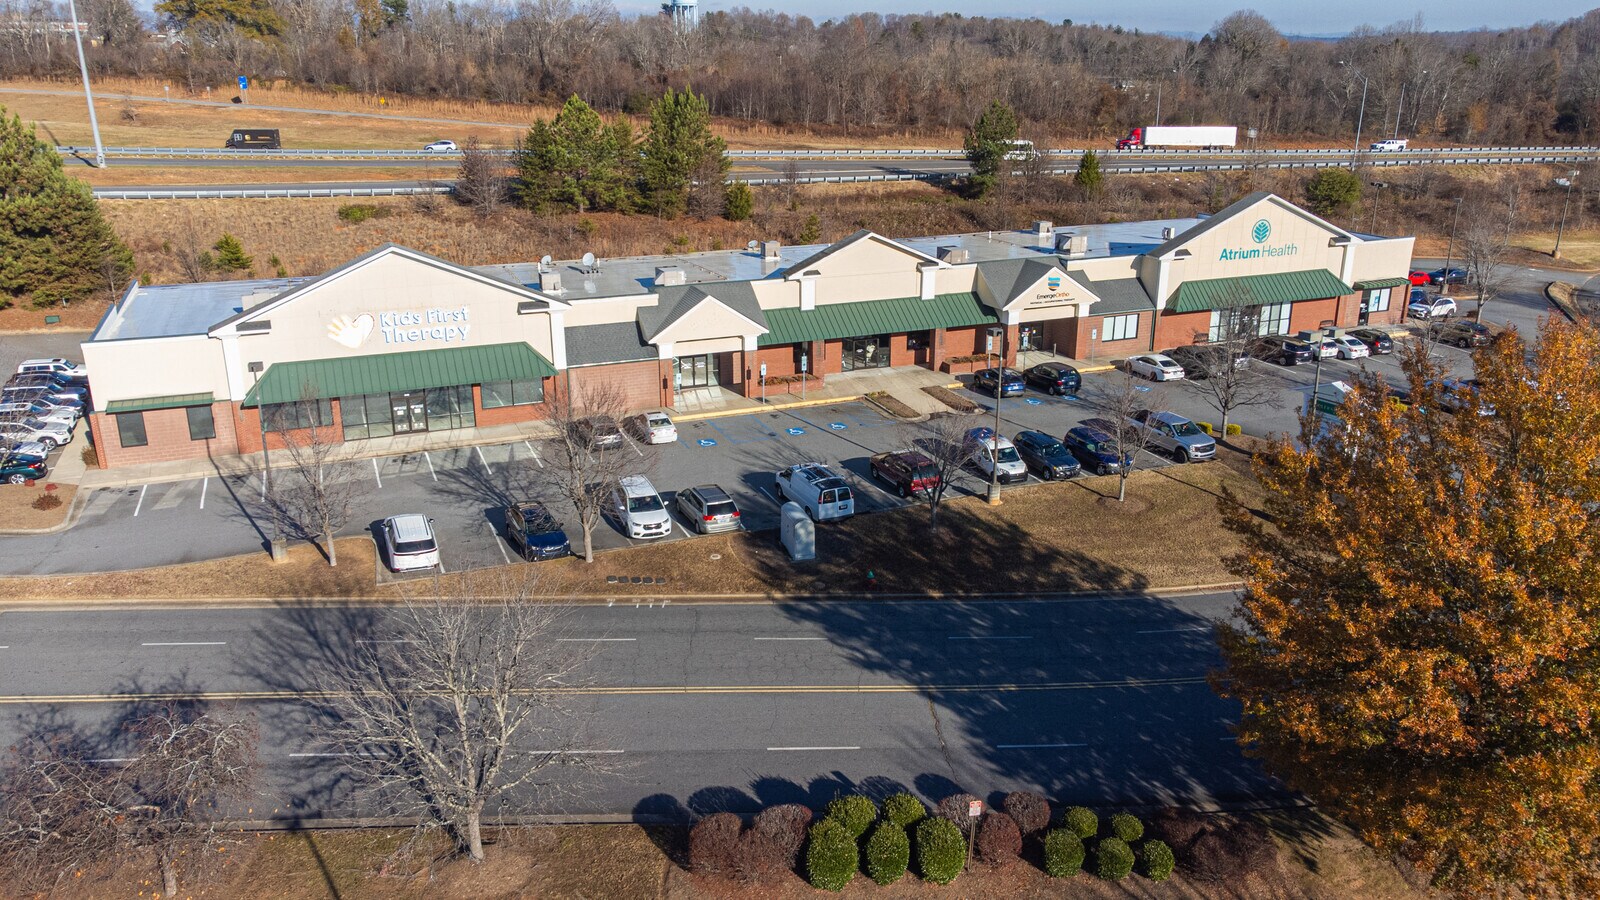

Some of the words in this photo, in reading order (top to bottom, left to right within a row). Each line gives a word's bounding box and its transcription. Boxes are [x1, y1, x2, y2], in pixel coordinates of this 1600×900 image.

[1219, 247, 1260, 261] Atrium
[1262, 243, 1298, 257] Health
[1036, 292, 1070, 300] EmergeOrtho
[380, 310, 422, 328] Kids
[426, 306, 470, 324] First
[381, 324, 471, 343] Therapy
